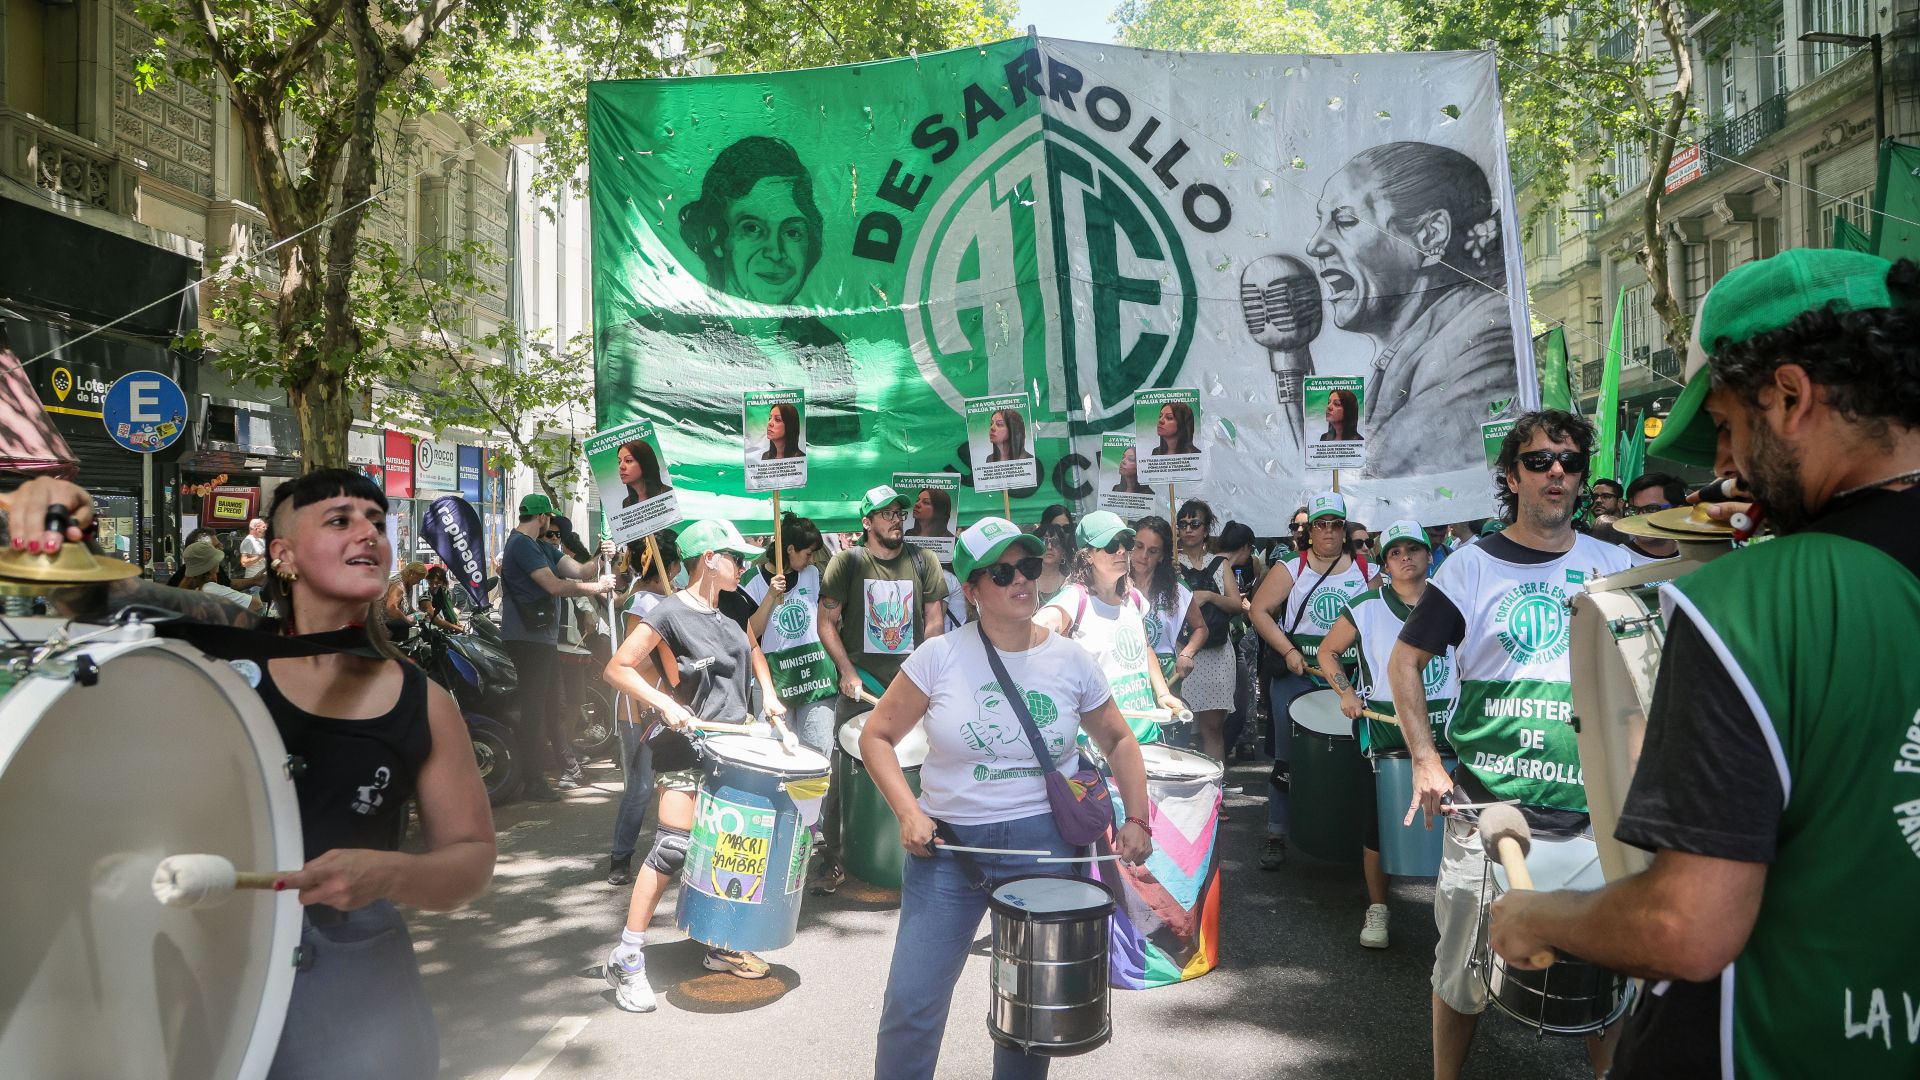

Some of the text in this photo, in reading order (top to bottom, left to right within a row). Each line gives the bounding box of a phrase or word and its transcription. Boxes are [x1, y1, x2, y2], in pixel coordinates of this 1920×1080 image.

[852, 47, 1232, 264] DESARROLLO
[928, 137, 1169, 415] ATE
[77, 391, 89, 402] de
[90, 393, 100, 403] la
[130, 381, 160, 422] E
[386, 457, 410, 465] MATERIALES
[421, 448, 453, 463] R ROCCO
[438, 506, 483, 584] rapipago
[1495, 582, 1538, 623] FORTALECER
[1540, 582, 1549, 594] EL
[782, 608, 804, 630] ATE
[1514, 601, 1558, 647] ATE
[1497, 631, 1515, 654] PARA
[1543, 651, 1554, 663] LA
[780, 650, 825, 670] MINISTERIO
[801, 668, 811, 679] DE
[782, 677, 831, 698] DESARROLLO
[1520, 728, 1545, 749] DE
[990, 771, 1027, 780] DESARROLLO
[722, 834, 763, 854] MACRI
[1844, 988, 1892, 1050] LA
